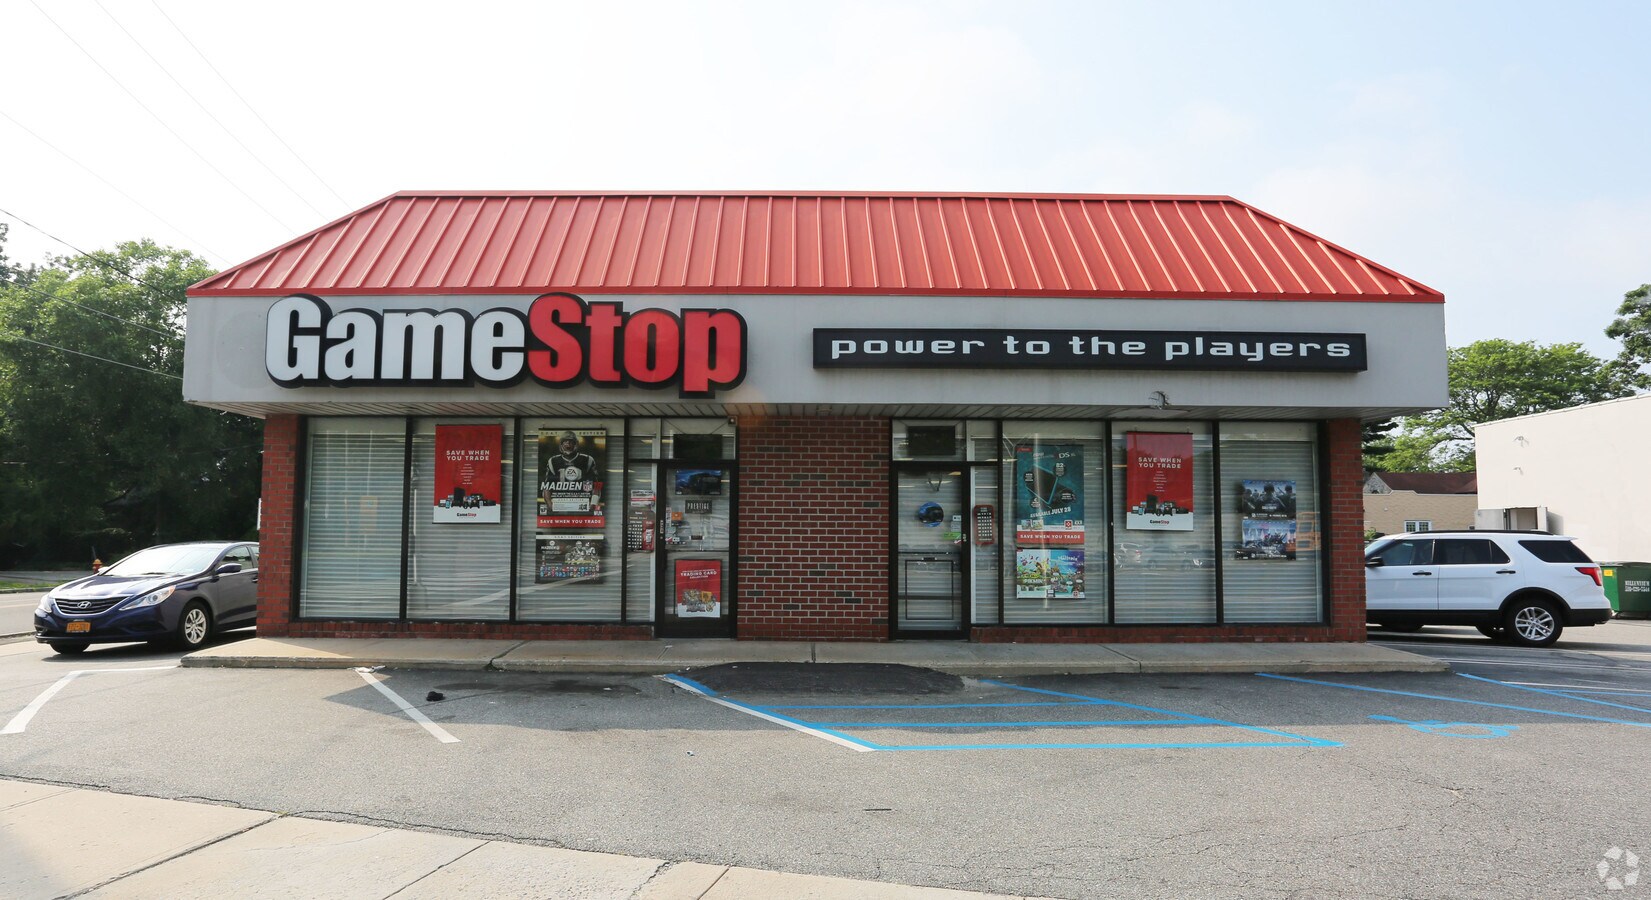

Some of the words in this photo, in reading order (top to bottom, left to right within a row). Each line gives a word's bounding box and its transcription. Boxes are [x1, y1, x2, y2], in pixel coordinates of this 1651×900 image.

[265, 292, 745, 396] GameStop
[831, 338, 985, 360] power
[1003, 335, 1051, 355] to
[1068, 336, 1147, 356] the
[1164, 337, 1351, 361] players
[540, 481, 583, 490] MADDEN
[1051, 507, 1064, 515] JULY
